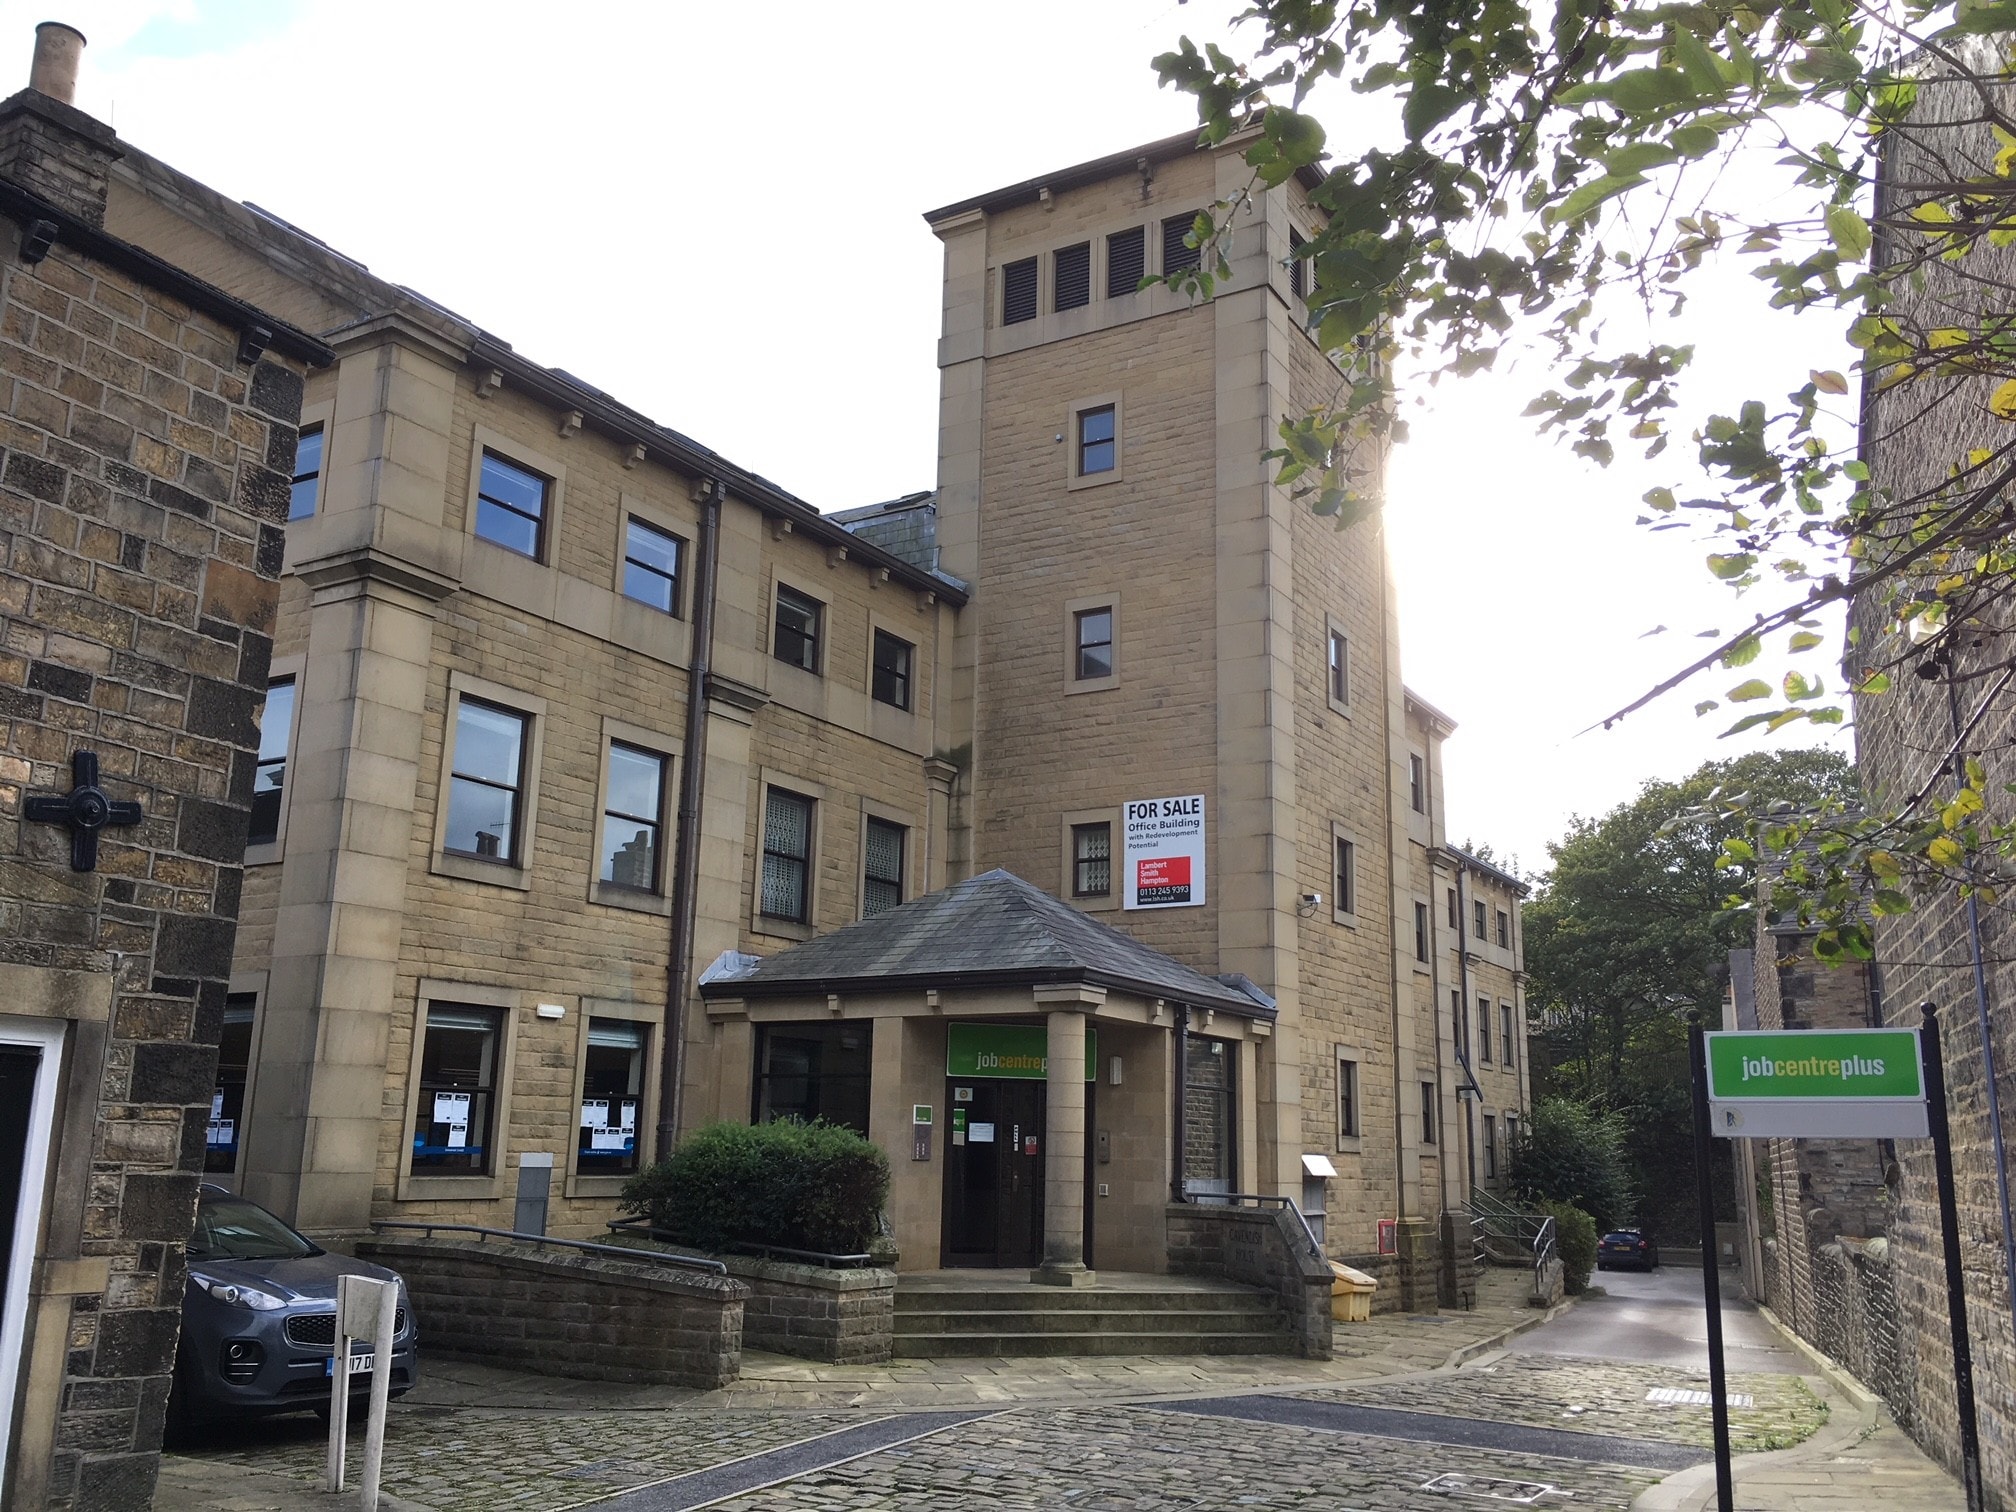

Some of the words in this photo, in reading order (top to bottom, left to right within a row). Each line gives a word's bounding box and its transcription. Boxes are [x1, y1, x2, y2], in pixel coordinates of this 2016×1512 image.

[1128, 802, 1158, 820] FOR
[1163, 798, 1200, 817] SALE
[1128, 823, 1157, 832] Office
[1159, 818, 1200, 829] Building
[1128, 833, 1144, 841] with
[1145, 829, 1198, 839] Redevelopment
[1128, 841, 1159, 849] Potential
[1140, 861, 1167, 869] Lambert
[1140, 869, 1159, 877] Smith
[1140, 877, 1169, 885] Hampton
[1140, 887, 1157, 896] 0113
[1157, 886, 1171, 895] 245
[1171, 885, 1189, 894] 9393
[1742, 1054, 1885, 1081] jobcentreplus
